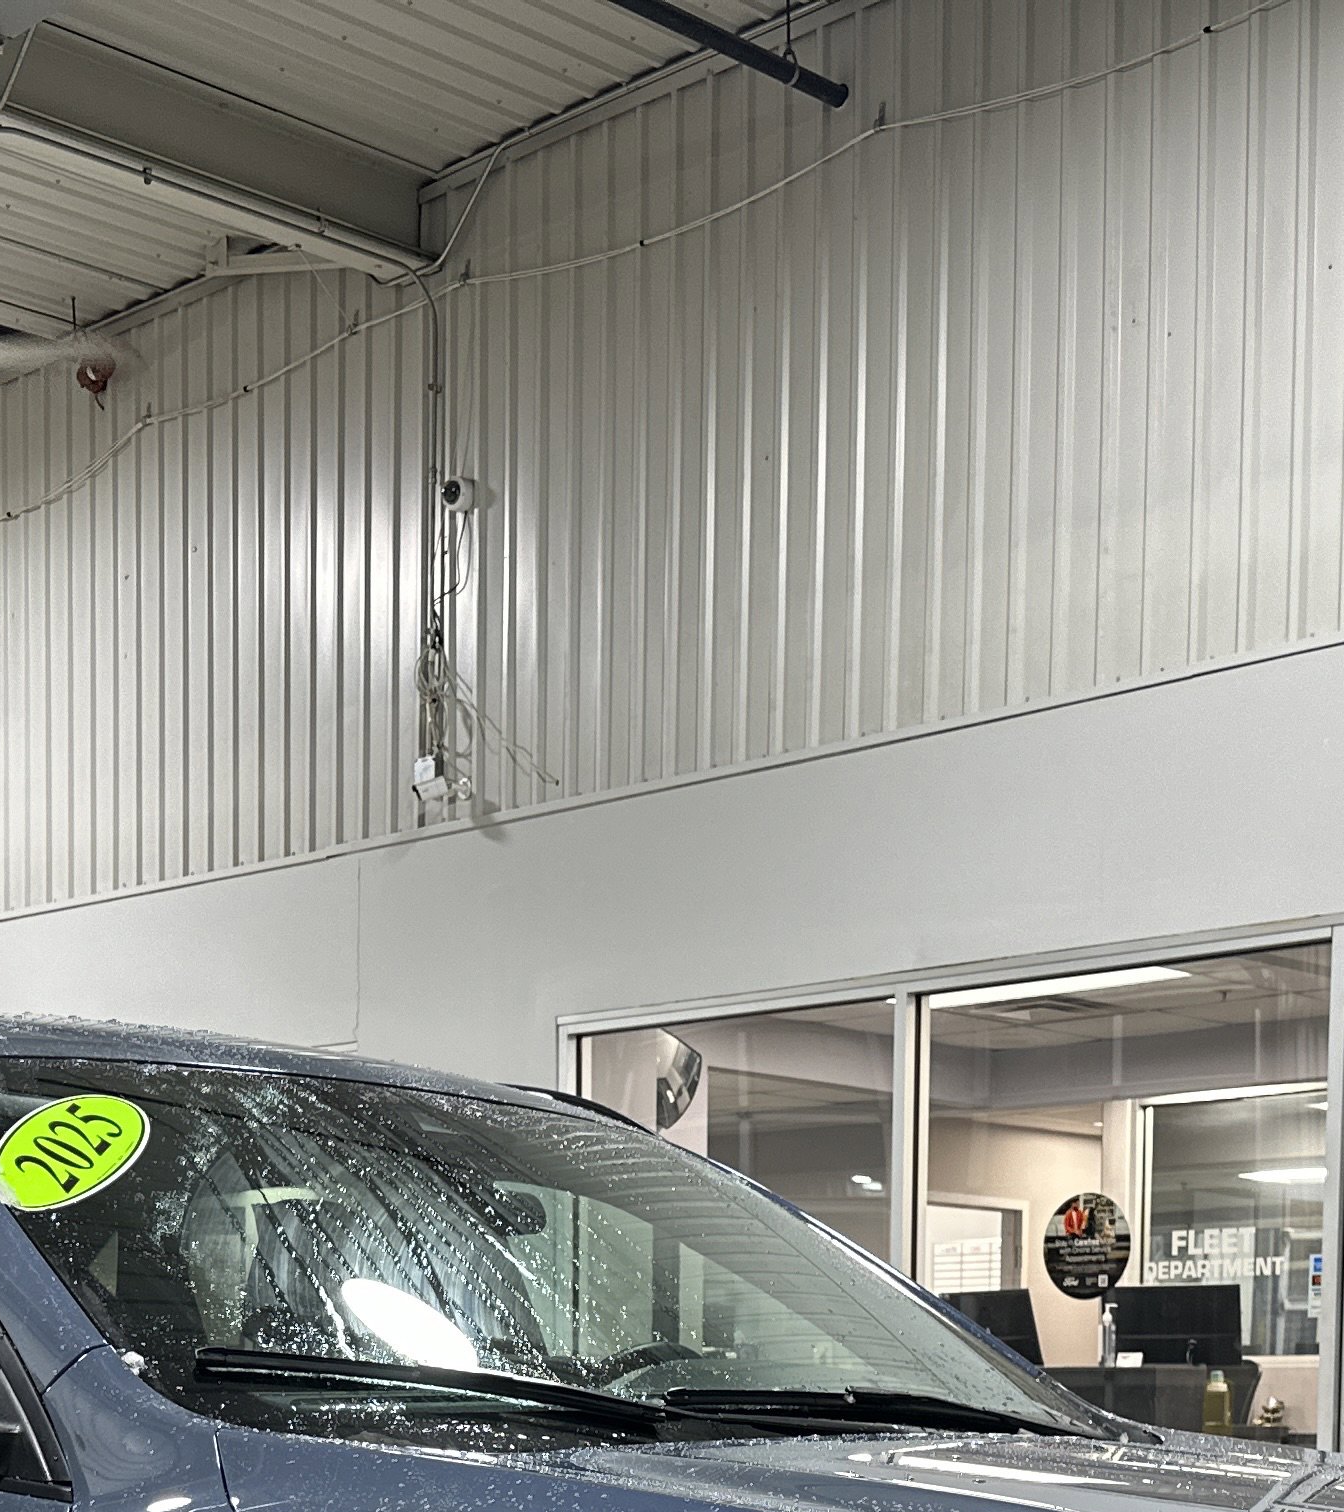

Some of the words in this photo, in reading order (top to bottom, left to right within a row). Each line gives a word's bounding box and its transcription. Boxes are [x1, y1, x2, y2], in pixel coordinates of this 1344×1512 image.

[14, 1102, 123, 1194] 2025
[1170, 1226, 1256, 1257] FLEET
[1145, 1256, 1286, 1282] DEPARTMENT
